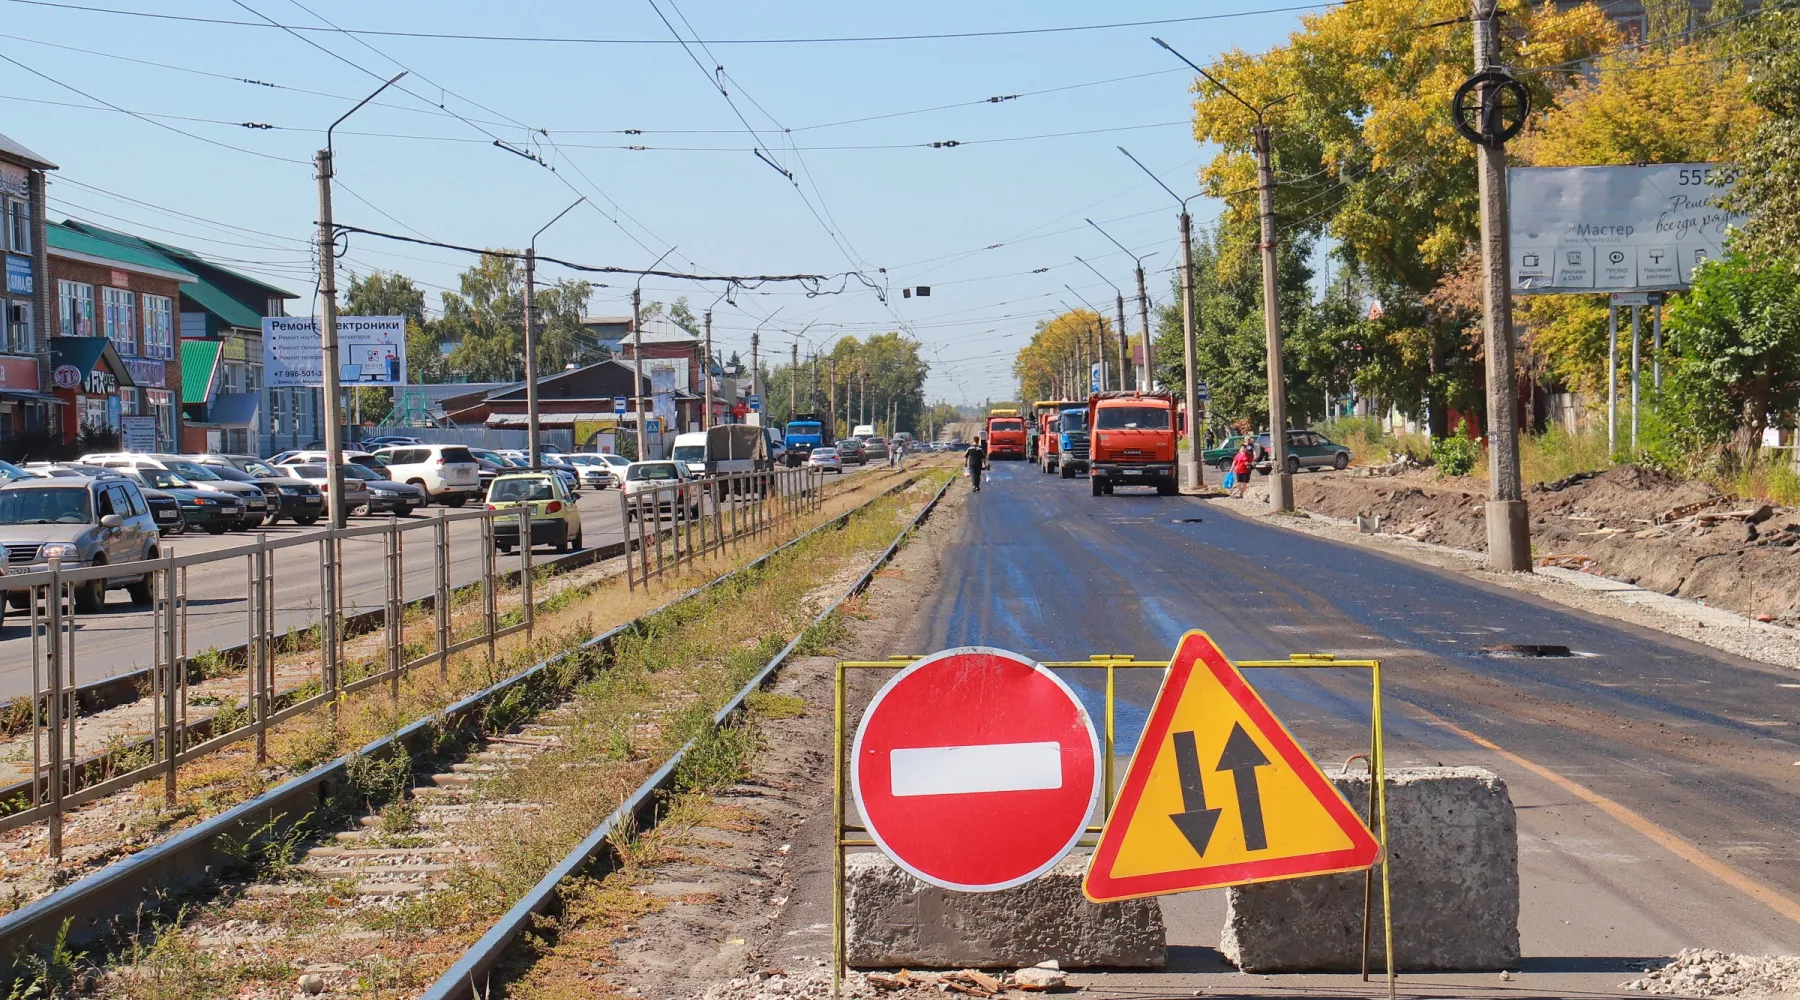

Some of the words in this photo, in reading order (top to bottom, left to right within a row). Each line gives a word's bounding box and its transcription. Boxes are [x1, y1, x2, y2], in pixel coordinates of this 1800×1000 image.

[1577, 223, 1634, 237] Мастер
[1656, 211, 1697, 240] всегда
[272, 321, 317, 331] Ремонт
